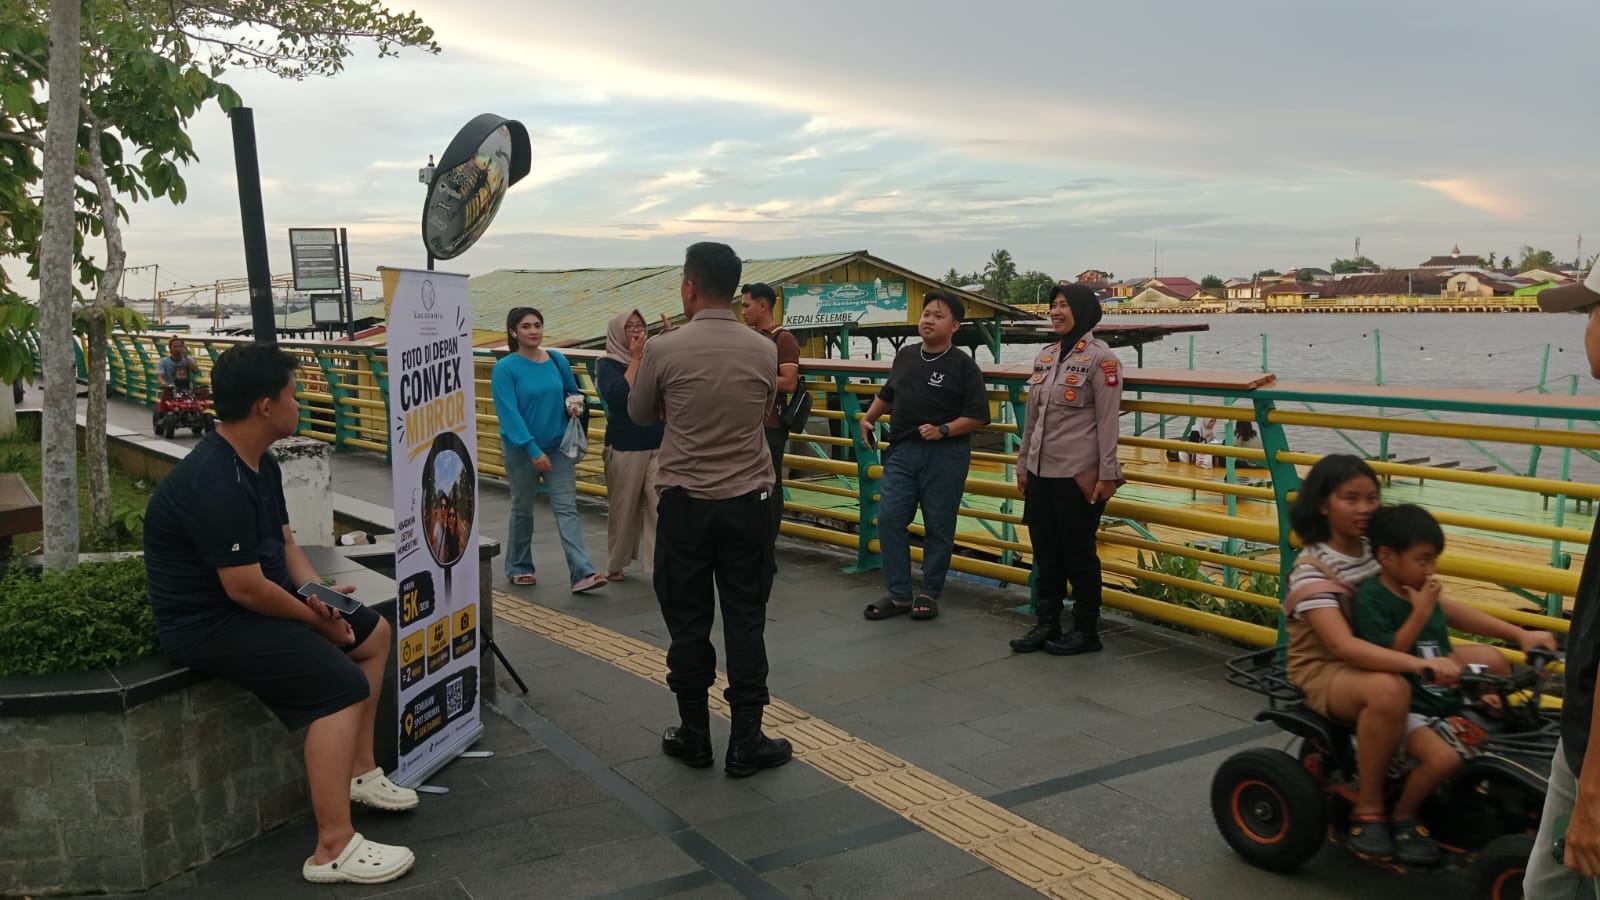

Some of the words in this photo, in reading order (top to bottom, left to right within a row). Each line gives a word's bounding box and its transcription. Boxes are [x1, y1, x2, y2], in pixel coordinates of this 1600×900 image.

[786, 315, 813, 325] KEDAI
[815, 312, 853, 323] SELEMBE
[402, 346, 422, 372] FOTO
[424, 343, 432, 364] DI
[433, 336, 458, 361] DEPAN
[1065, 365, 1089, 374] POLRI
[400, 356, 462, 412] CONVEX
[405, 390, 465, 448] MIRROR
[403, 589, 419, 622] 5K
